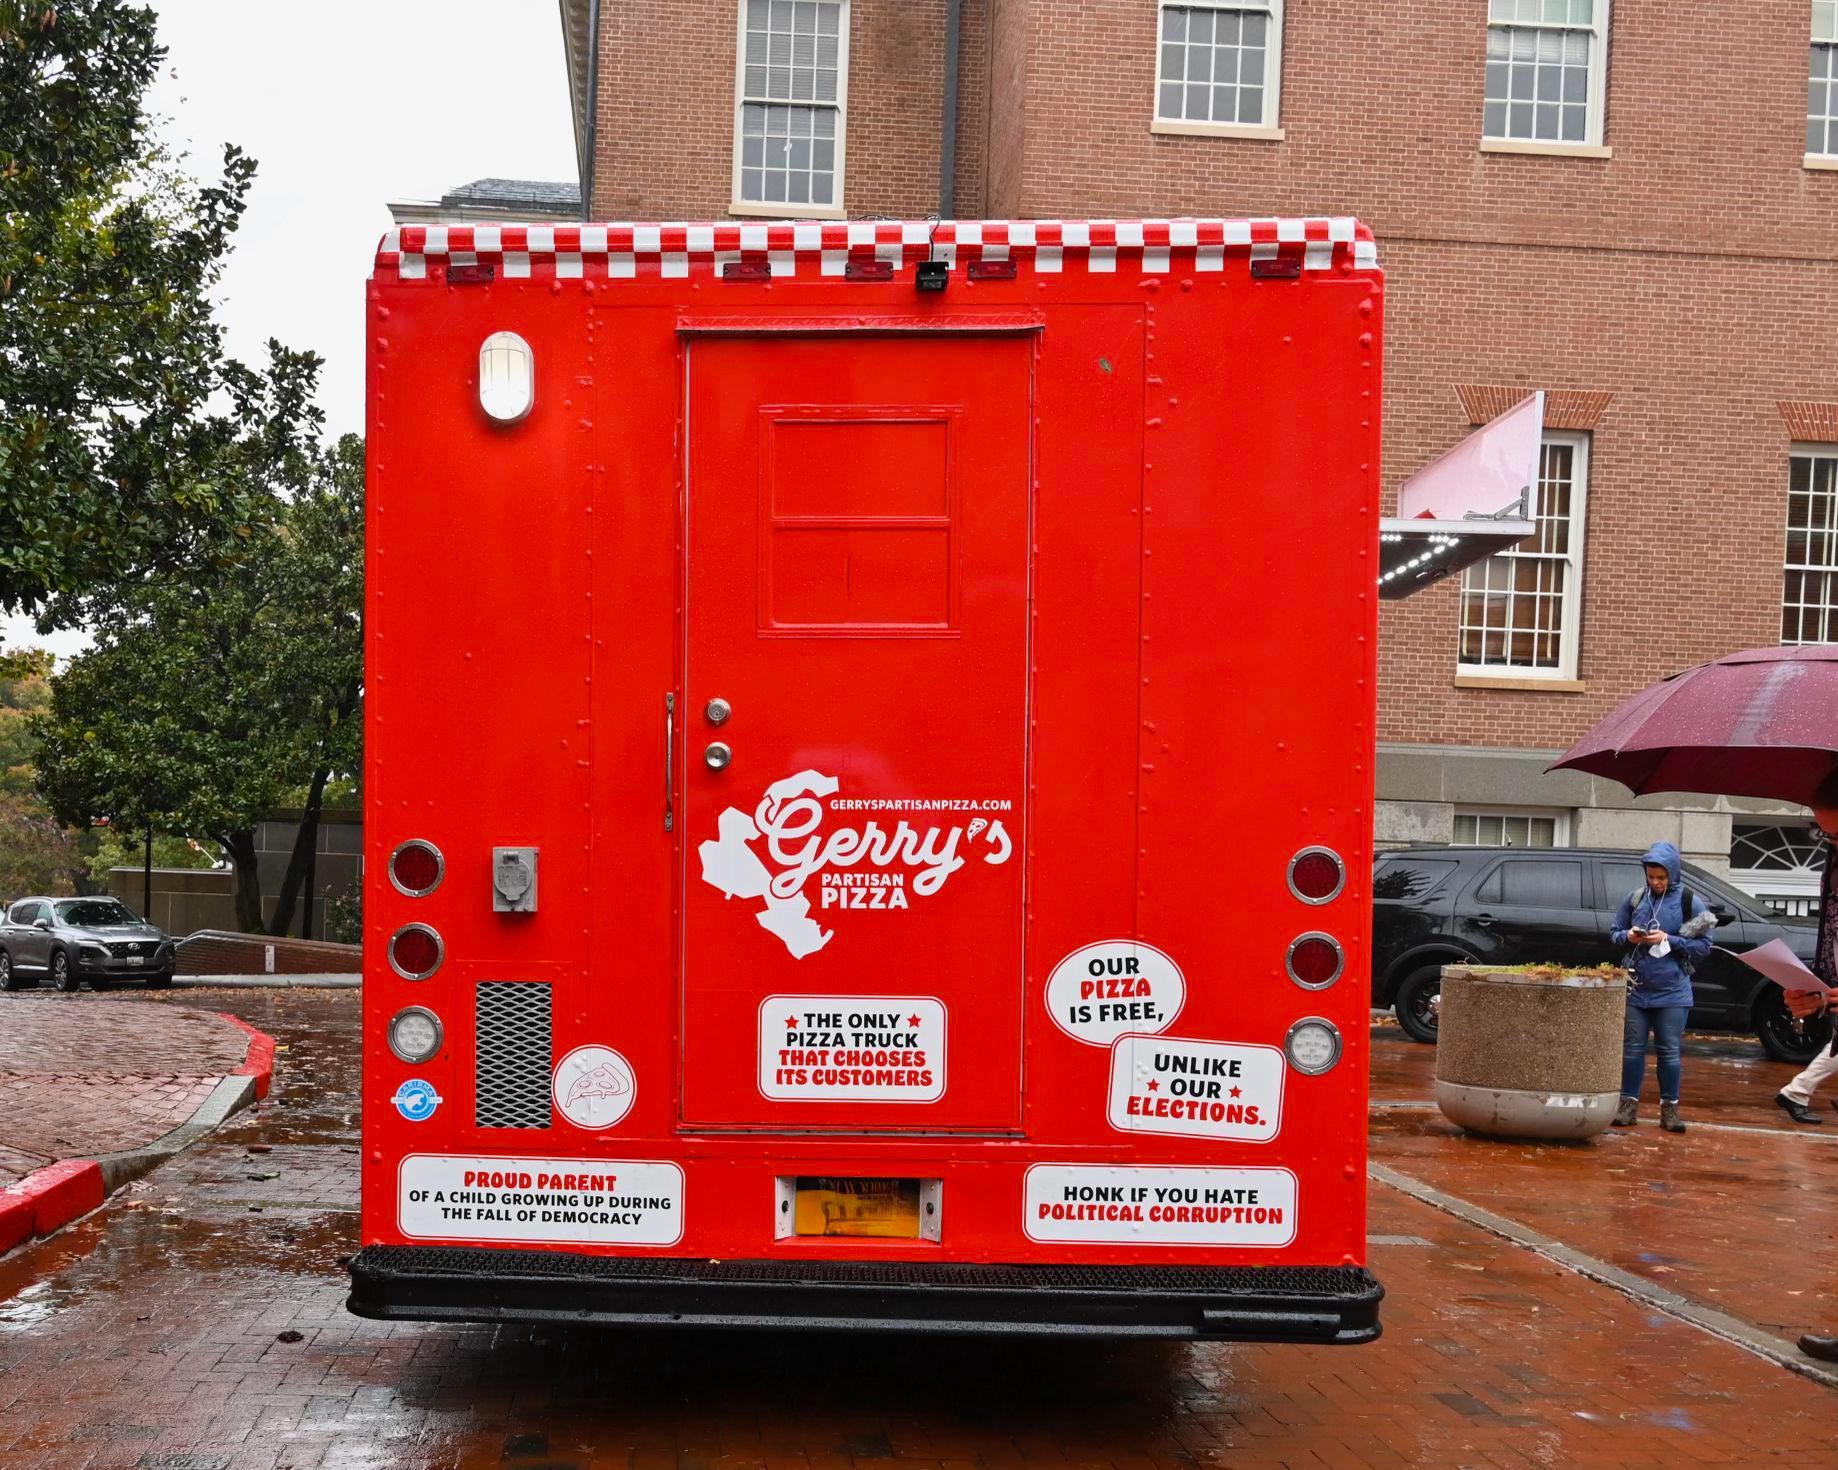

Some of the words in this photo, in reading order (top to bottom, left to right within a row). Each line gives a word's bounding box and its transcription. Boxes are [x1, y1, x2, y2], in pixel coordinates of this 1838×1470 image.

[830, 800, 1011, 810] GERRYSPARTISANPIZZA.COM
[754, 797, 1013, 896] Gerry's
[822, 874, 903, 886] PARTISAN
[822, 888, 908, 909] PIZZA
[1089, 957, 1139, 976] OUR
[1081, 978, 1151, 1000] PIZZA
[804, 1013, 842, 1028] THE
[848, 1014, 900, 1028] ONLY
[1070, 1006, 1091, 1023] IS
[1100, 1002, 1163, 1022] FREE,
[787, 1032, 845, 1047] PIZZA
[851, 1033, 918, 1048] TRUCK
[779, 1050, 829, 1066] THAT
[834, 1050, 925, 1067] CHOOSES
[1155, 1054, 1241, 1077] UNLIKE
[776, 1069, 807, 1085] ITS
[812, 1069, 932, 1086] CUSTOMERS
[1170, 1079, 1221, 1098] OUR
[1127, 1095, 1266, 1125] ELECTIONS.
[464, 1171, 532, 1188] PROUD
[538, 1174, 616, 1191] PARENT
[410, 1190, 429, 1202] OF
[434, 1191, 444, 1202] A
[450, 1192, 496, 1204] CHILD
[502, 1193, 578, 1206] GROWING
[584, 1196, 604, 1207] UP
[609, 1197, 670, 1209] DURING
[1064, 1187, 1124, 1201] HONK
[1131, 1188, 1148, 1202] IF
[1155, 1188, 1197, 1203] YOU
[1205, 1189, 1258, 1204] HATE
[442, 1208, 471, 1219] THE
[477, 1209, 512, 1221] FALL
[517, 1210, 536, 1221] OF
[542, 1211, 641, 1224] DEMOCRACY
[1039, 1204, 1144, 1221] POLITICAL
[1149, 1206, 1282, 1224] CORRUPTION
